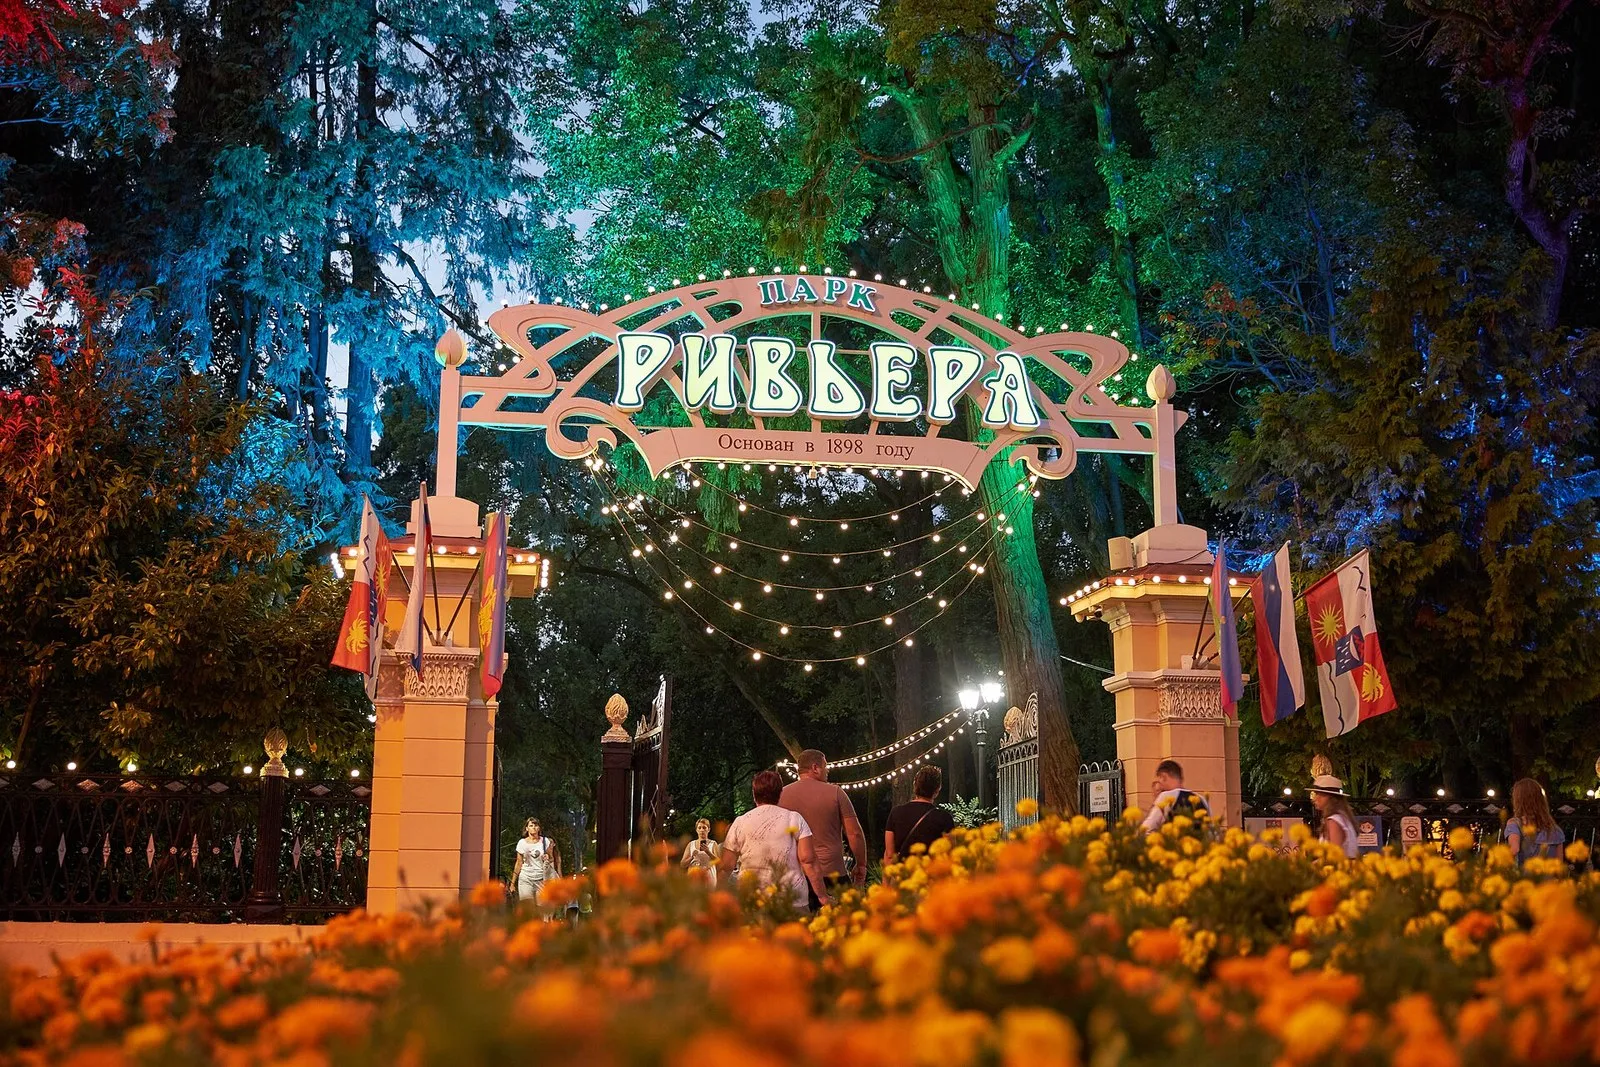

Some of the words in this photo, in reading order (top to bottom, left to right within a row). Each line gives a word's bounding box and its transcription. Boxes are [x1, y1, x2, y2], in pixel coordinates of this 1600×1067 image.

[759, 276, 877, 312] ПАРК
[615, 331, 1041, 431] РИВЬЕРА
[718, 433, 794, 452] Основан
[805, 442, 815, 453] в
[826, 438, 864, 455] 1898
[876, 444, 914, 460] году
